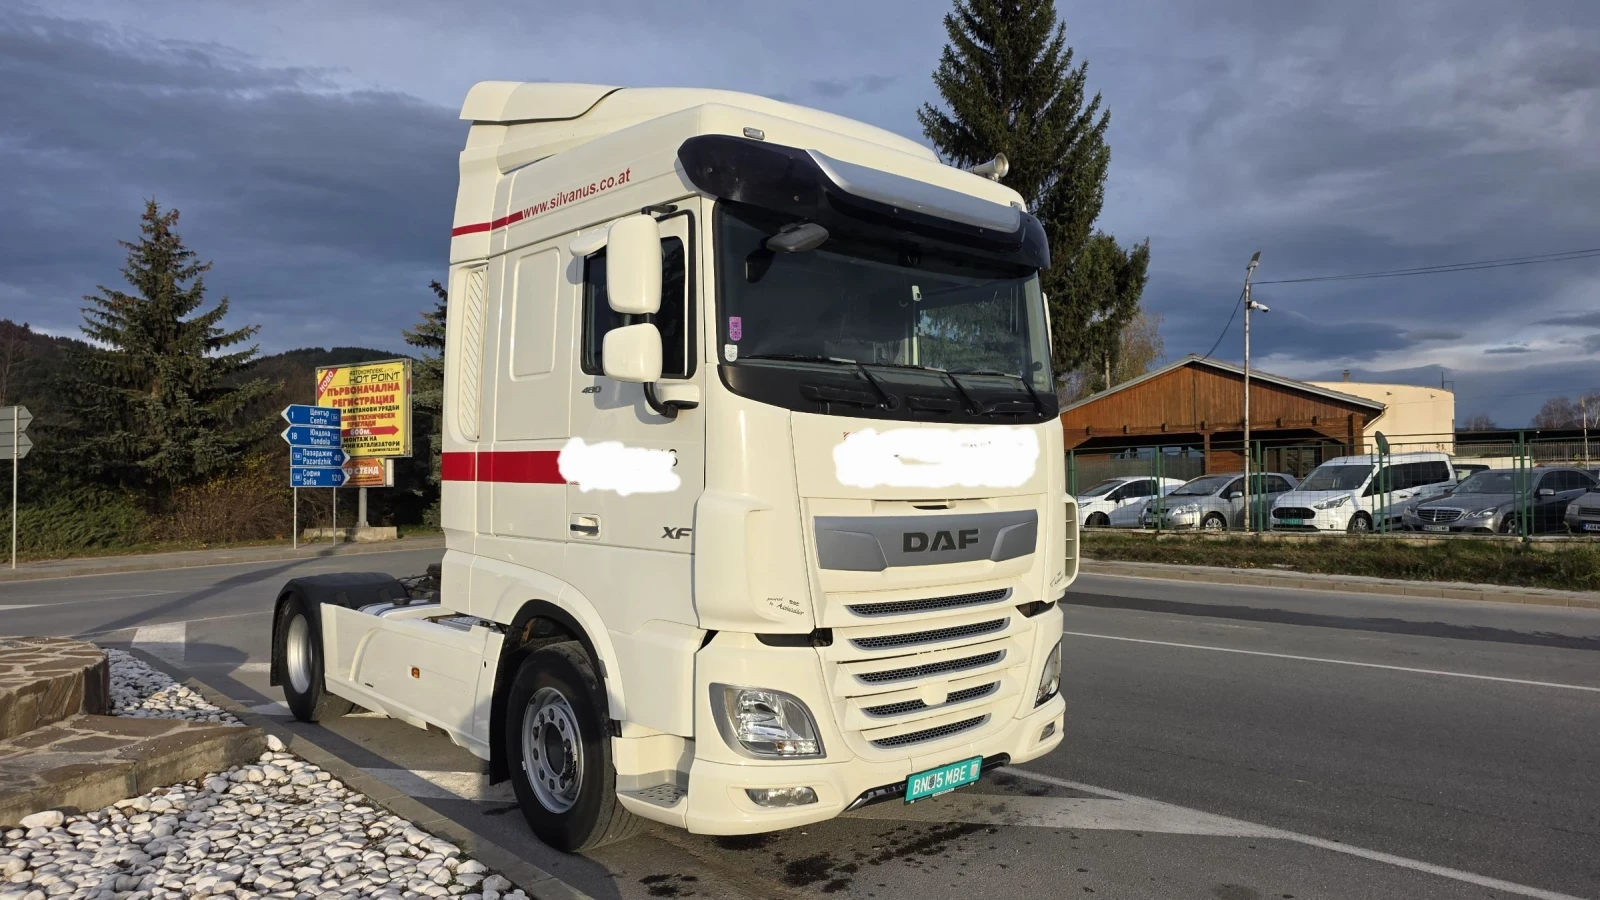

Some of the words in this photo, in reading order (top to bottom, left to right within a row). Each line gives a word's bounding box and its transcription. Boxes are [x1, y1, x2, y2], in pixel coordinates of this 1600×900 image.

[522, 167, 631, 219] www.silvanus.co.at
[320, 370, 334, 392] НОВО
[349, 375, 369, 385] HOT
[371, 371, 400, 382] POINT
[327, 382, 400, 397] ПЪРВОНАЧАЛНА
[581, 385, 602, 394] 480
[332, 394, 395, 407] РЕГИСТРАЦИЯ
[310, 408, 330, 418] Център
[347, 406, 377, 414] МЕТАНОВИ
[310, 417, 328, 425] Centre
[291, 432, 298, 440] 18
[303, 448, 333, 458] Пазарджик
[334, 454, 342, 462] 40
[303, 457, 332, 466] Pazardzhik
[303, 469, 321, 477] София
[354, 466, 379, 476] СТЕНД
[303, 478, 317, 486] Sofia
[331, 474, 342, 482] 120
[661, 526, 693, 540] XF
[902, 528, 979, 553] DAF
[944, 764, 968, 787] MBE
